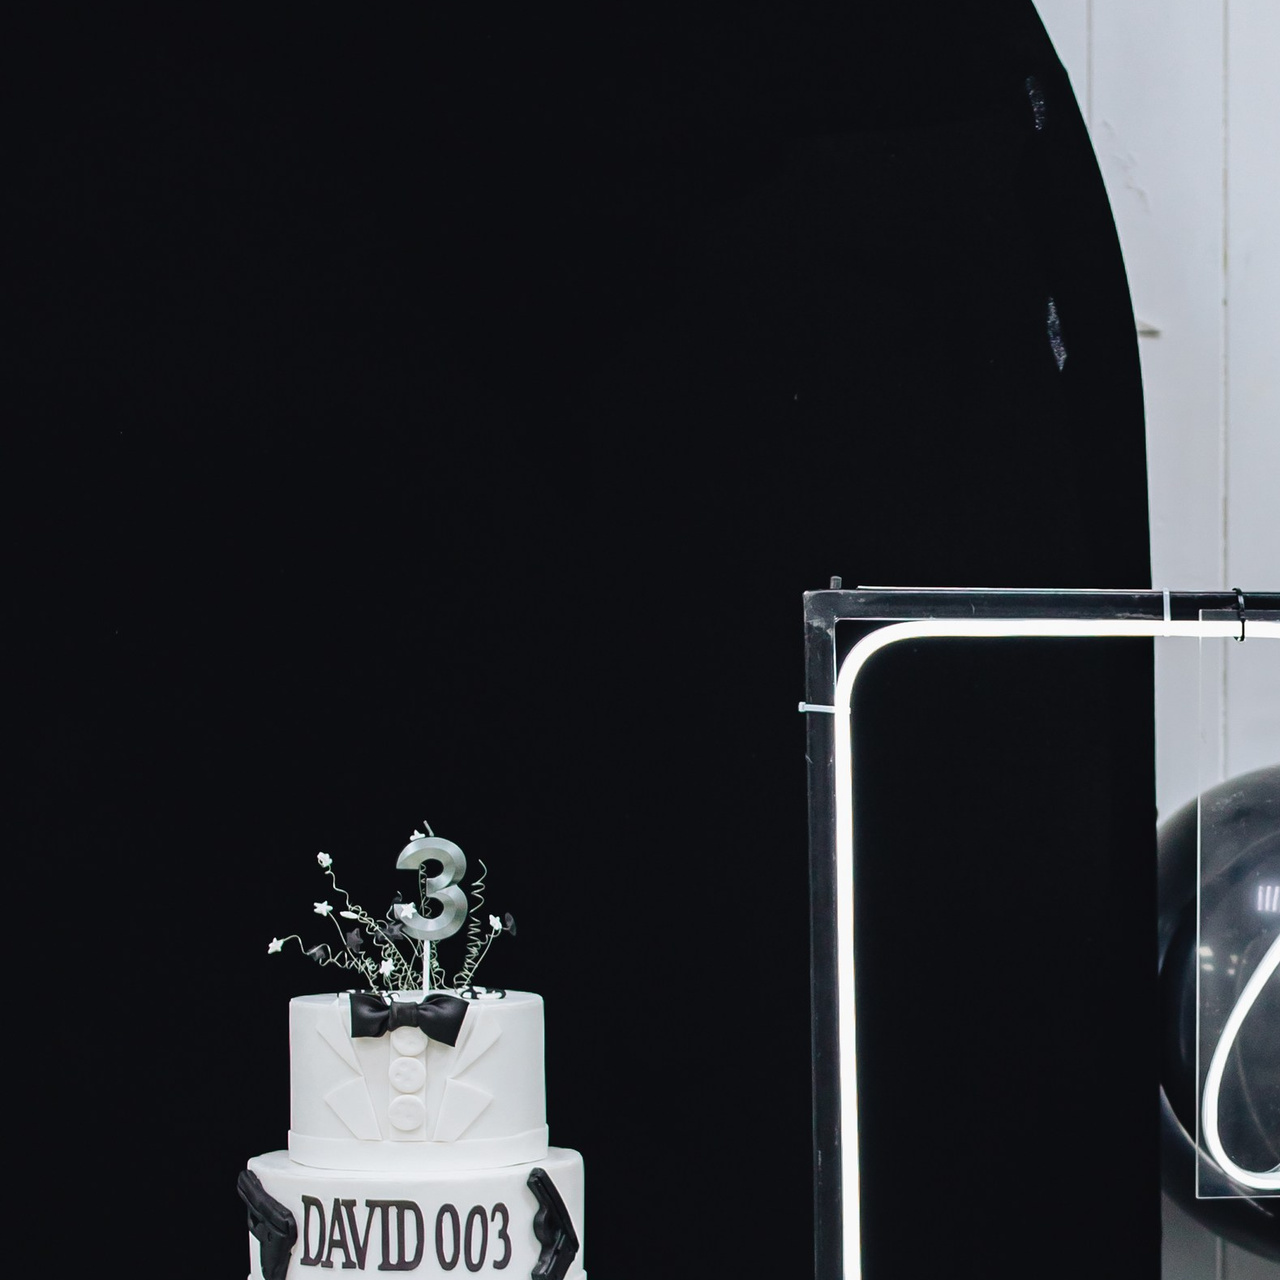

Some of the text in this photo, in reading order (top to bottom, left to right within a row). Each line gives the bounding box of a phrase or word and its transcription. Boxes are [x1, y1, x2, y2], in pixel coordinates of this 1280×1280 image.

[396, 837, 468, 941] 3
[300, 1195, 512, 1272] DAVID 003
